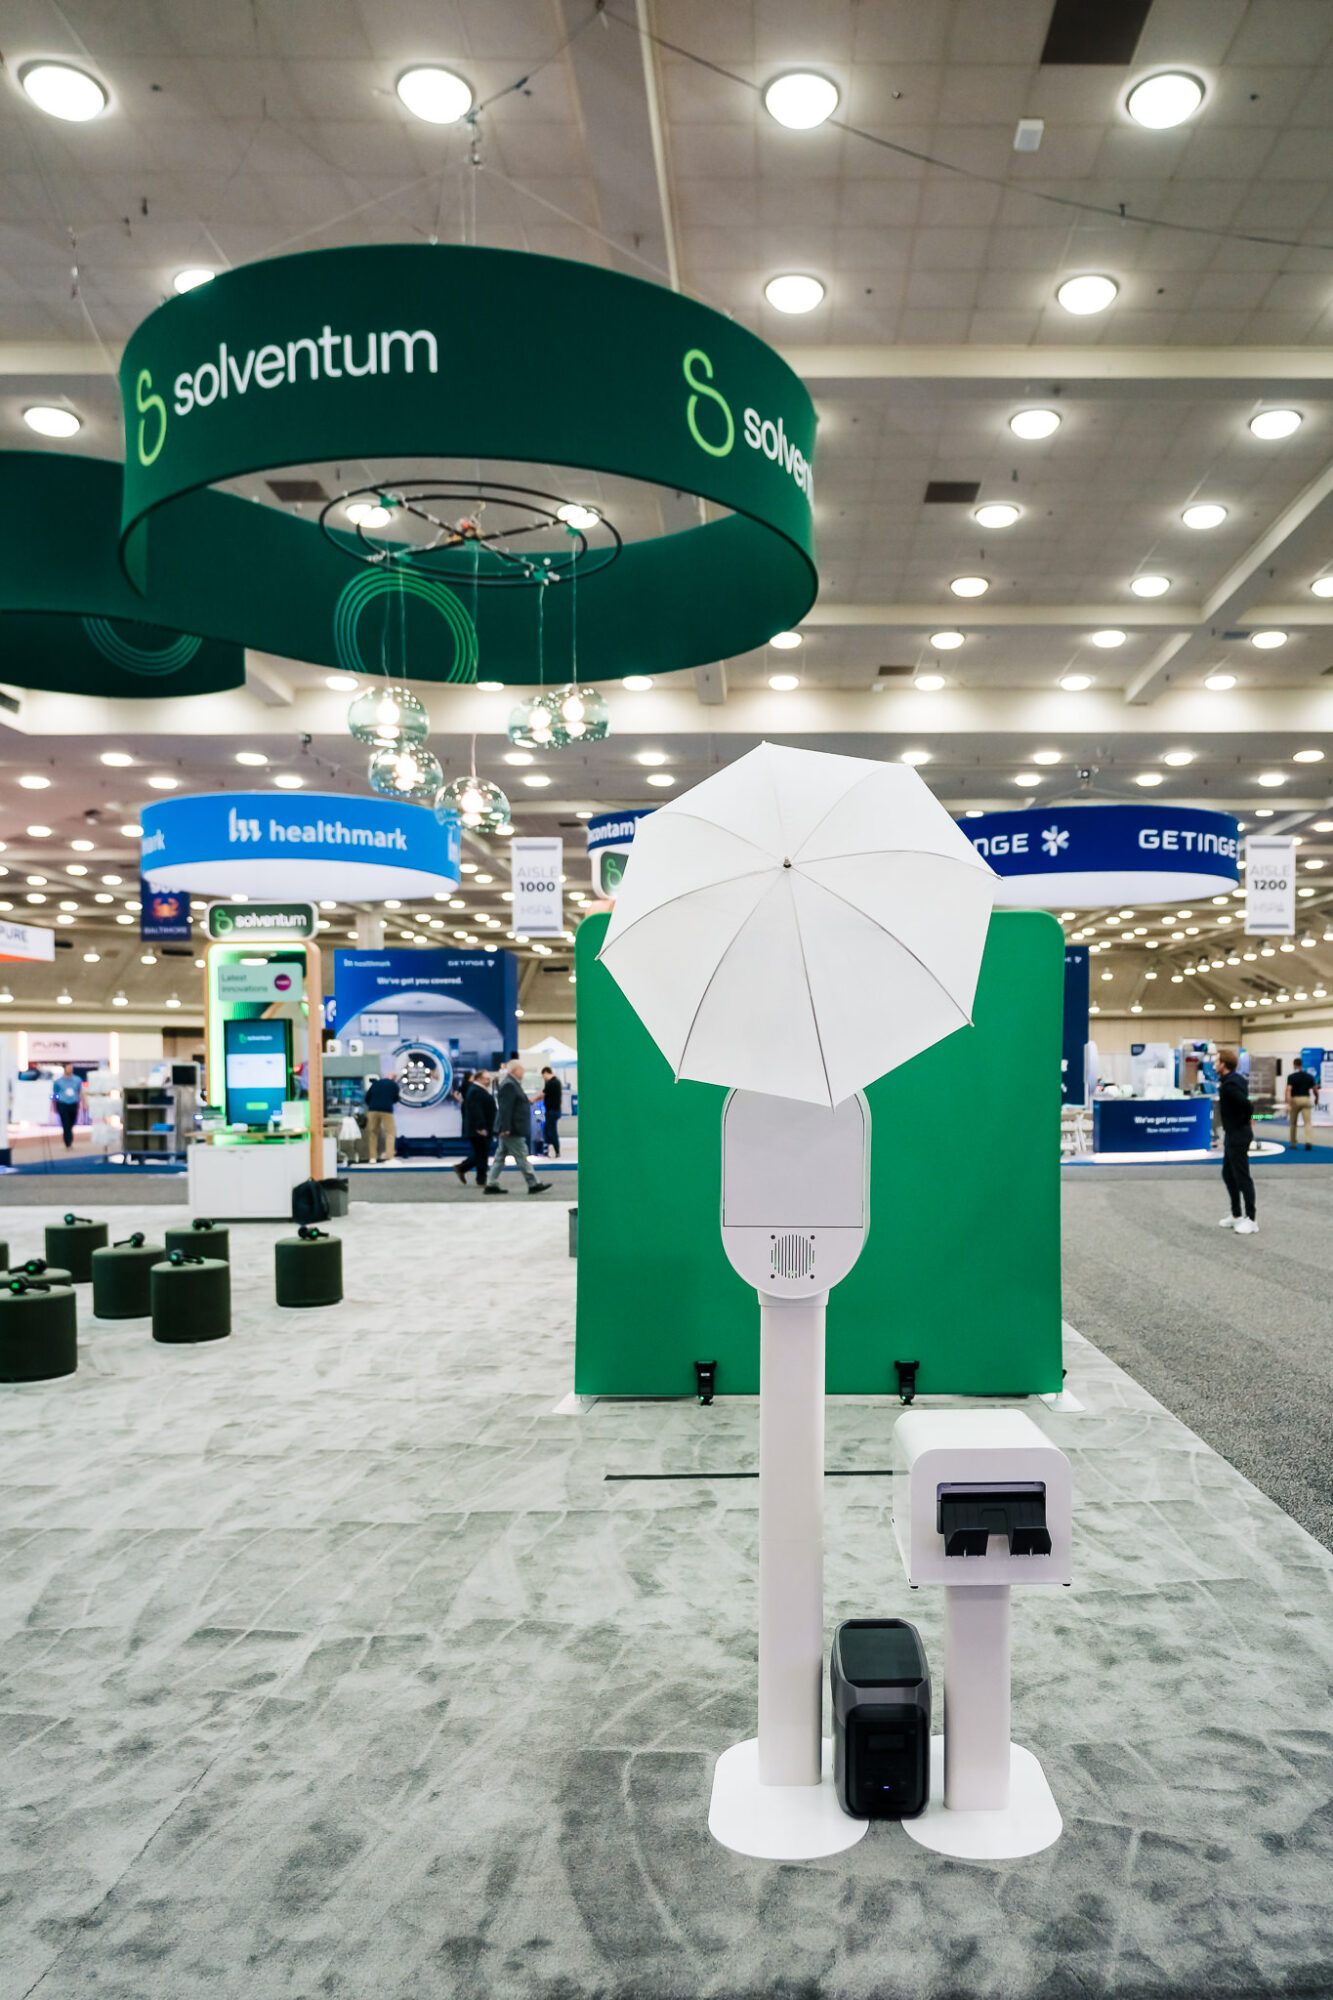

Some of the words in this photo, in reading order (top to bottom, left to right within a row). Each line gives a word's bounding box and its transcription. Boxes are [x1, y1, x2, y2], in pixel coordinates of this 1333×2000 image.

[174, 325, 439, 417] solventum
[269, 818, 408, 851] healthmark
[1138, 829, 1238, 859] GETINGE
[517, 867, 558, 878] AISLE
[1250, 864, 1290, 876] AISLE
[520, 882, 556, 892] 1000
[1253, 880, 1287, 890] 1200
[235, 912, 307, 927] solventum
[222, 974, 247, 982] Latest
[415, 977, 430, 986] you
